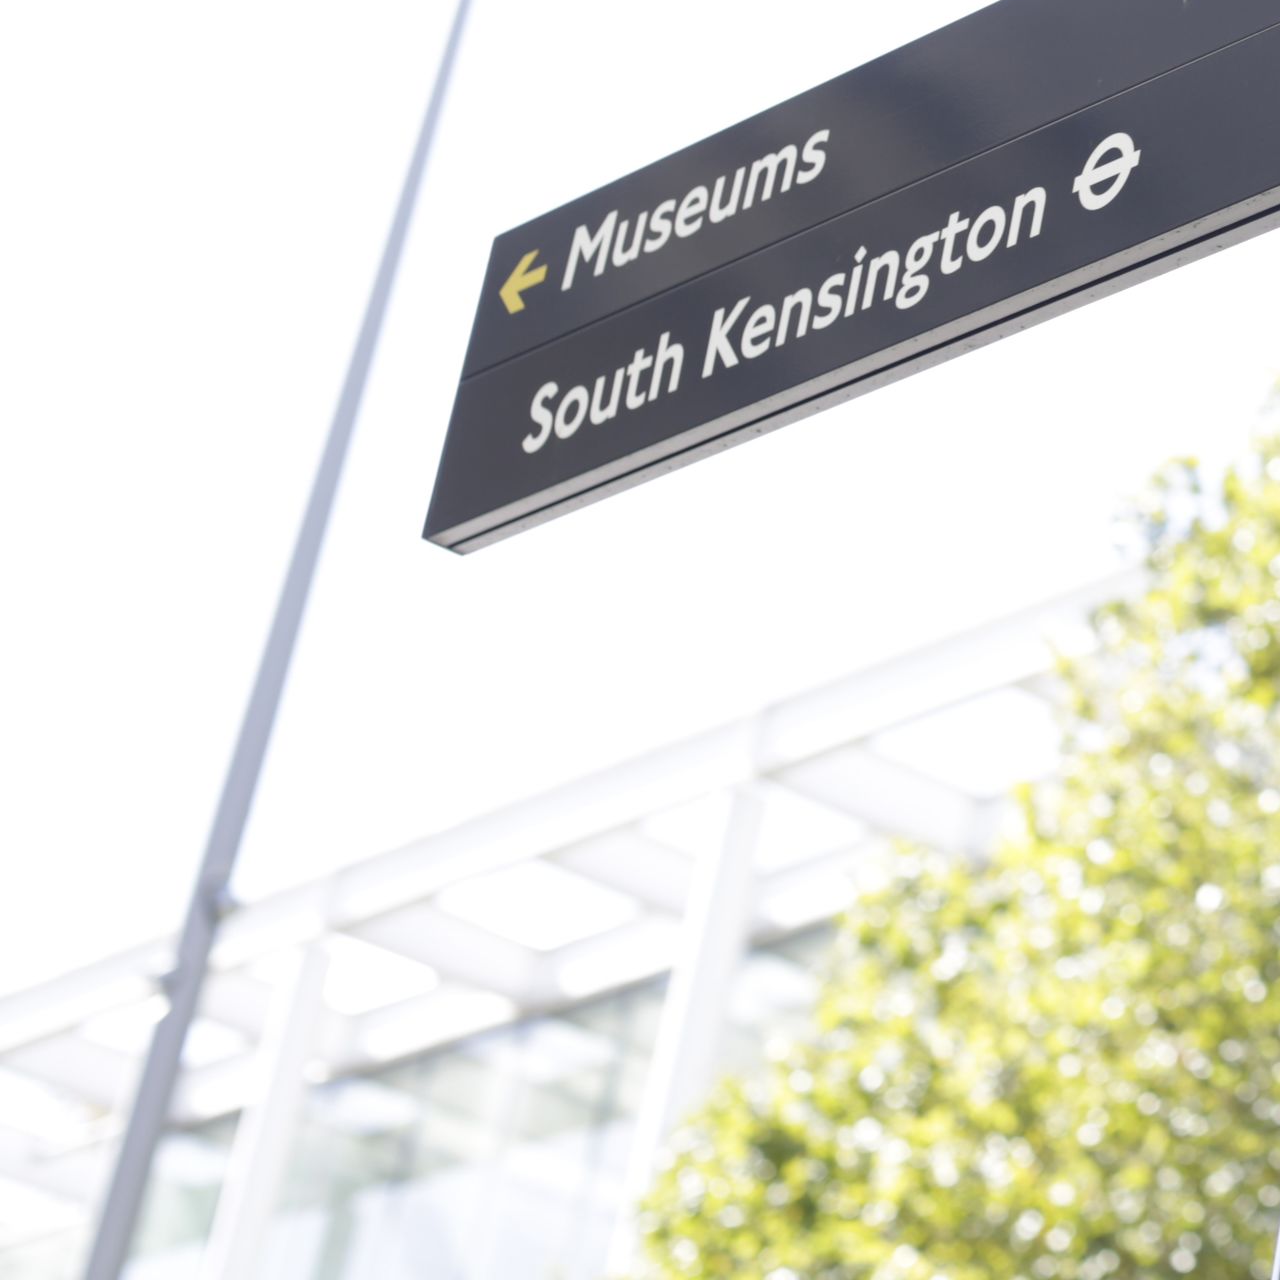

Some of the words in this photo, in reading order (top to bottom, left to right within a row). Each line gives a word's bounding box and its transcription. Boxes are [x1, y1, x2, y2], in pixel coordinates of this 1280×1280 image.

[561, 129, 830, 291] Museums
[522, 331, 684, 454] South
[701, 186, 1047, 379] Kensington
